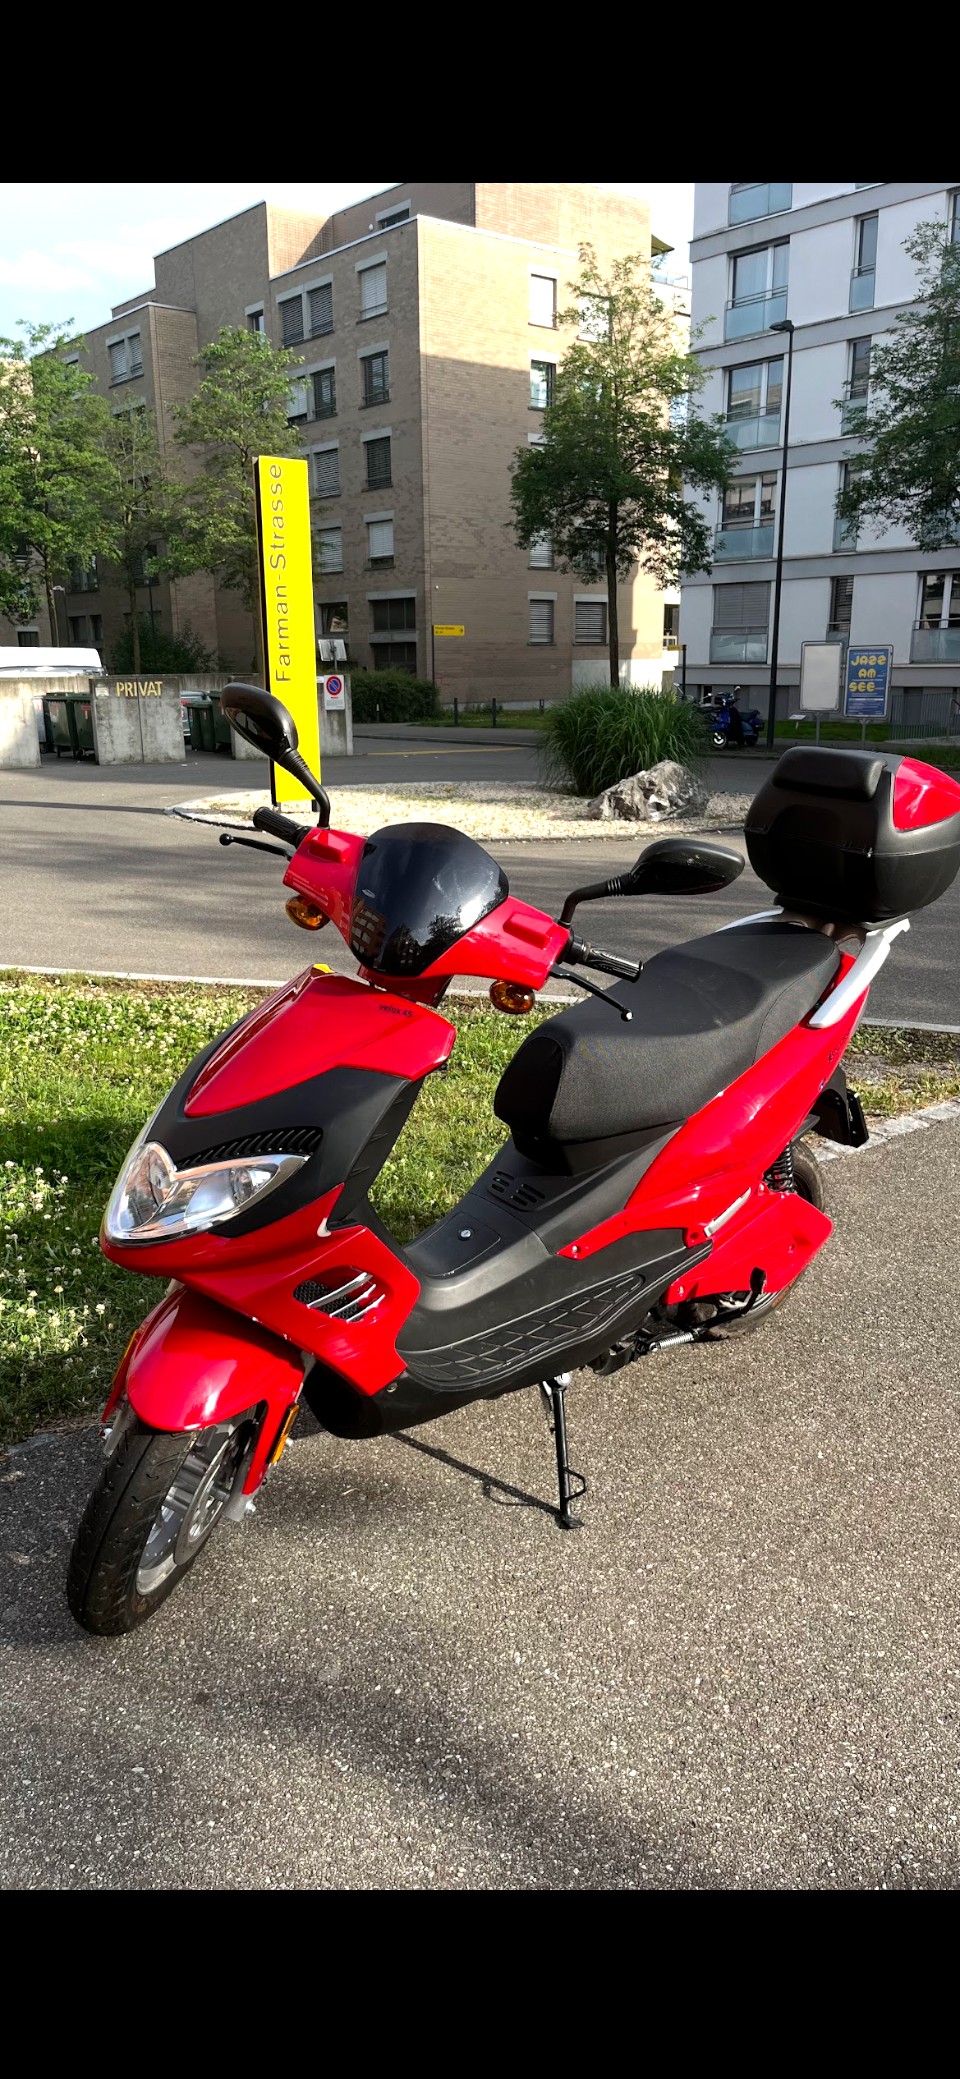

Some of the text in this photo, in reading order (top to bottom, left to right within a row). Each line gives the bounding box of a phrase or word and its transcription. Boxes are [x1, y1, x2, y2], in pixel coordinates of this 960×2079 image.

[269, 464, 291, 682] Farman-Strasse
[851, 655, 887, 666] JAZZ
[858, 668, 877, 679] AM
[116, 681, 163, 697] PRIVAT
[849, 681, 875, 692] SEE
